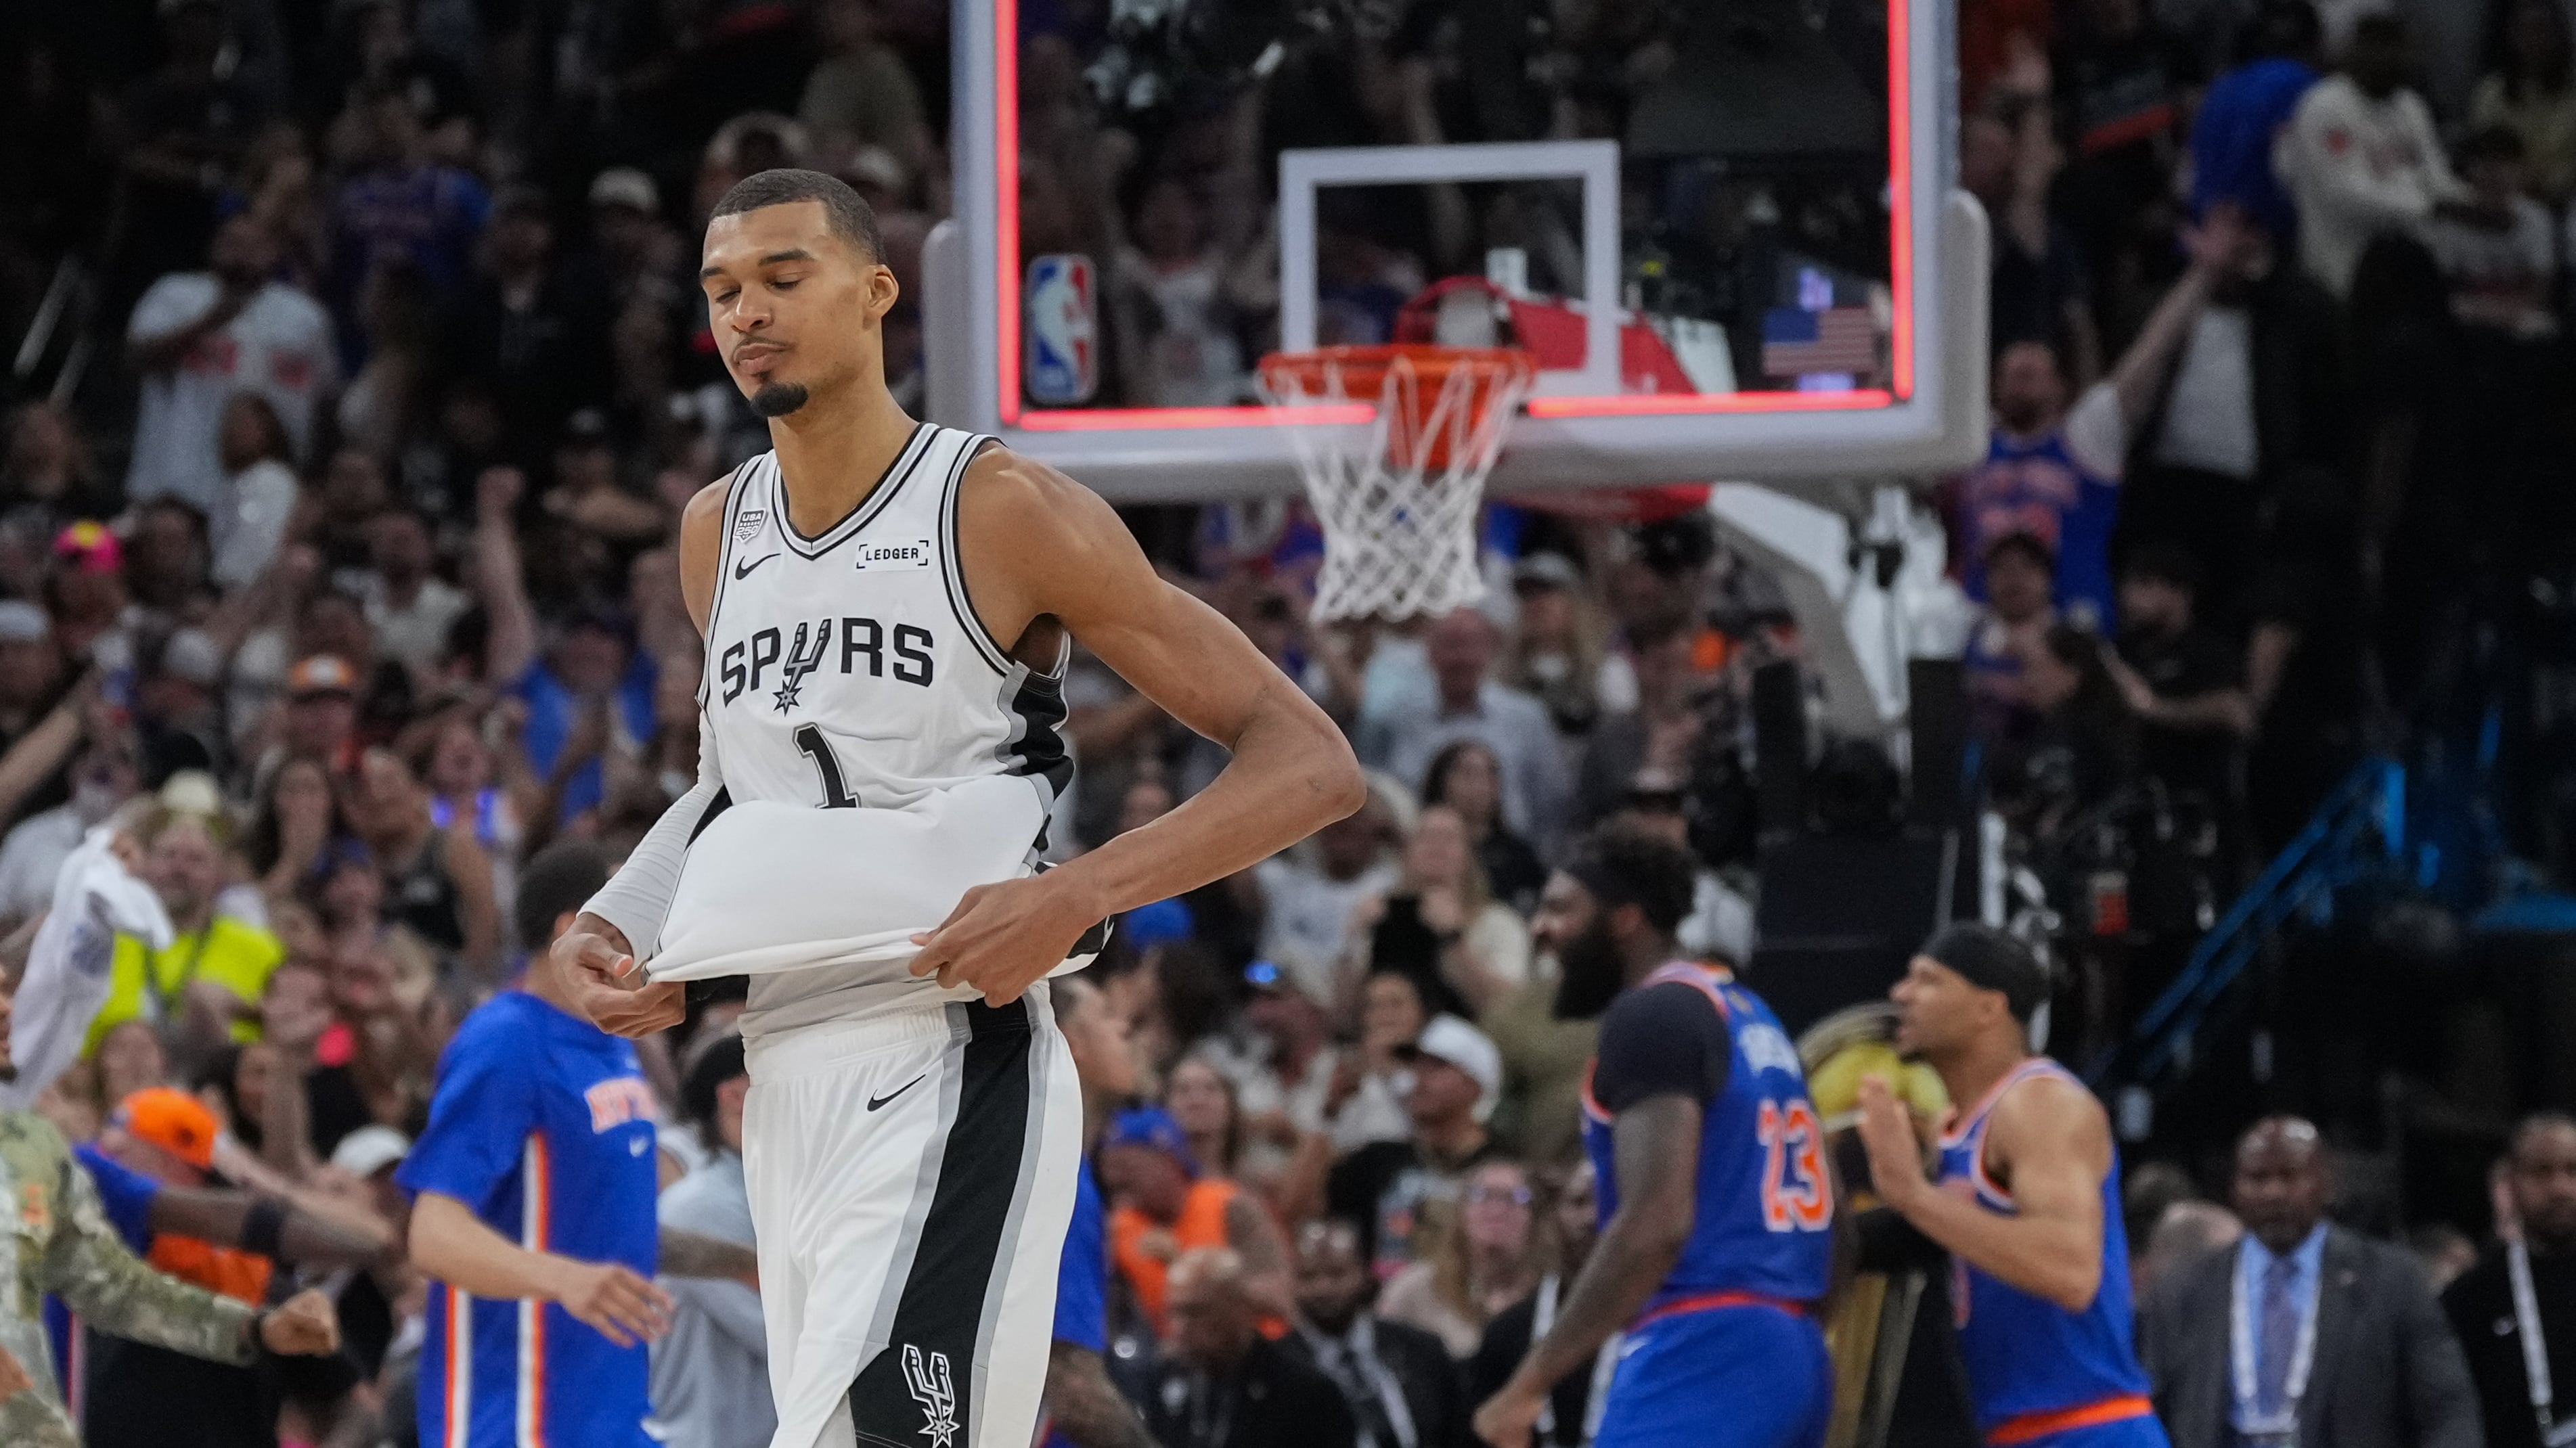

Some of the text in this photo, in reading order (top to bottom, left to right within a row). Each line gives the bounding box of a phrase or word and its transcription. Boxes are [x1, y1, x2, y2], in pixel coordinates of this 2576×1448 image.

[742, 513, 761, 521] USA
[736, 525, 759, 535] 250
[866, 547, 919, 561] LEDGER
[721, 616, 933, 716] SPURS
[792, 721, 862, 809] 1
